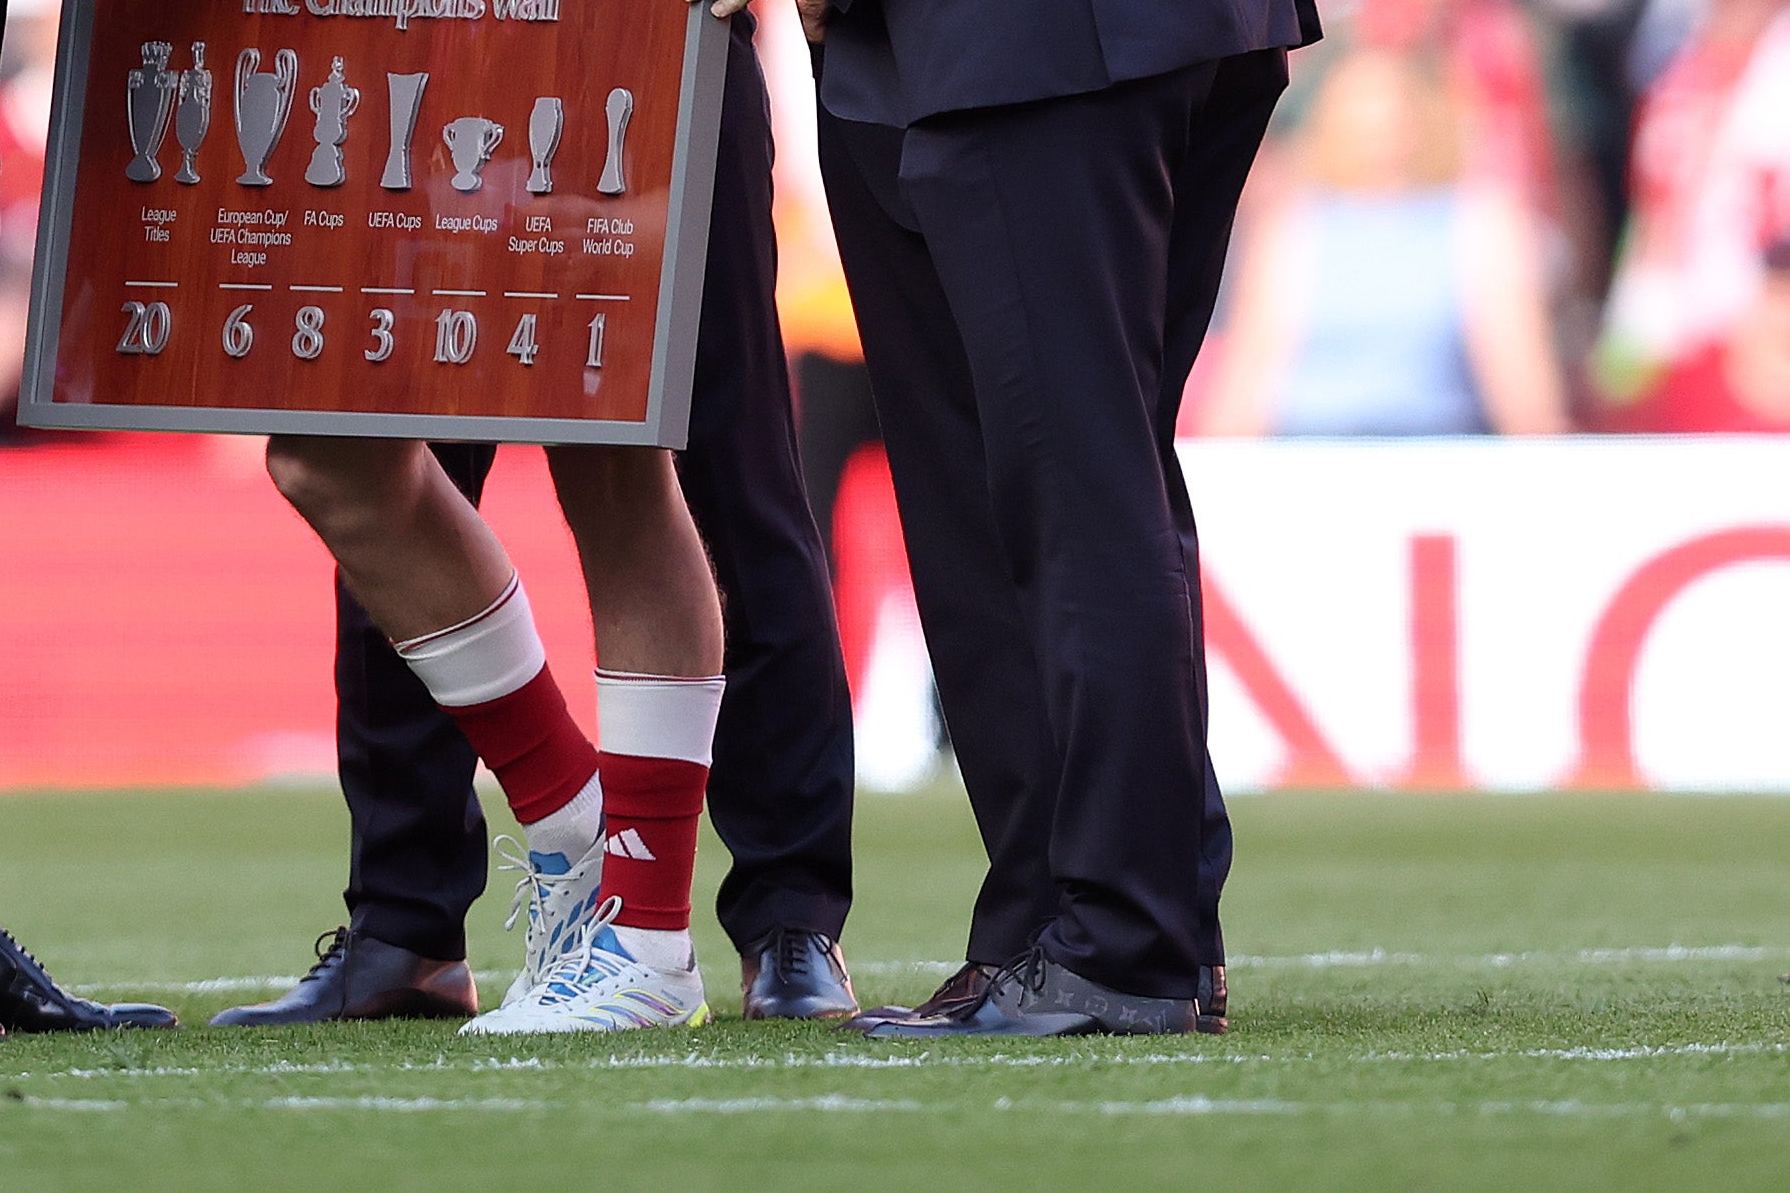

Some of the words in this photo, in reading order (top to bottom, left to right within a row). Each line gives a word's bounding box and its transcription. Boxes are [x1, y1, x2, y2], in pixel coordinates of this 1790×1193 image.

[141, 206, 177, 225] League
[217, 208, 263, 226] European
[264, 209, 289, 228] Cup/
[304, 210, 317, 226] FA
[318, 211, 344, 230] Cups
[368, 212, 395, 228] UEFA
[396, 213, 421, 232] Cups
[435, 214, 471, 233] League
[472, 214, 498, 234] Cups
[525, 216, 552, 232] UEFA
[144, 226, 170, 242] Titles
[587, 218, 610, 235] FIFA
[611, 218, 634, 235] Club
[210, 228, 235, 243] UEFA
[237, 228, 291, 248] Champions
[508, 236, 538, 255] Super
[538, 237, 564, 257] Cups
[231, 249, 267, 268] League
[582, 238, 611, 255] World
[613, 239, 634, 259] Cup
[115, 301, 172, 354] 20
[222, 304, 254, 358] 6
[291, 305, 326, 359] 8
[364, 308, 395, 362] 3
[433, 308, 477, 364] 10
[506, 313, 539, 364] 4
[585, 312, 606, 367] 1
